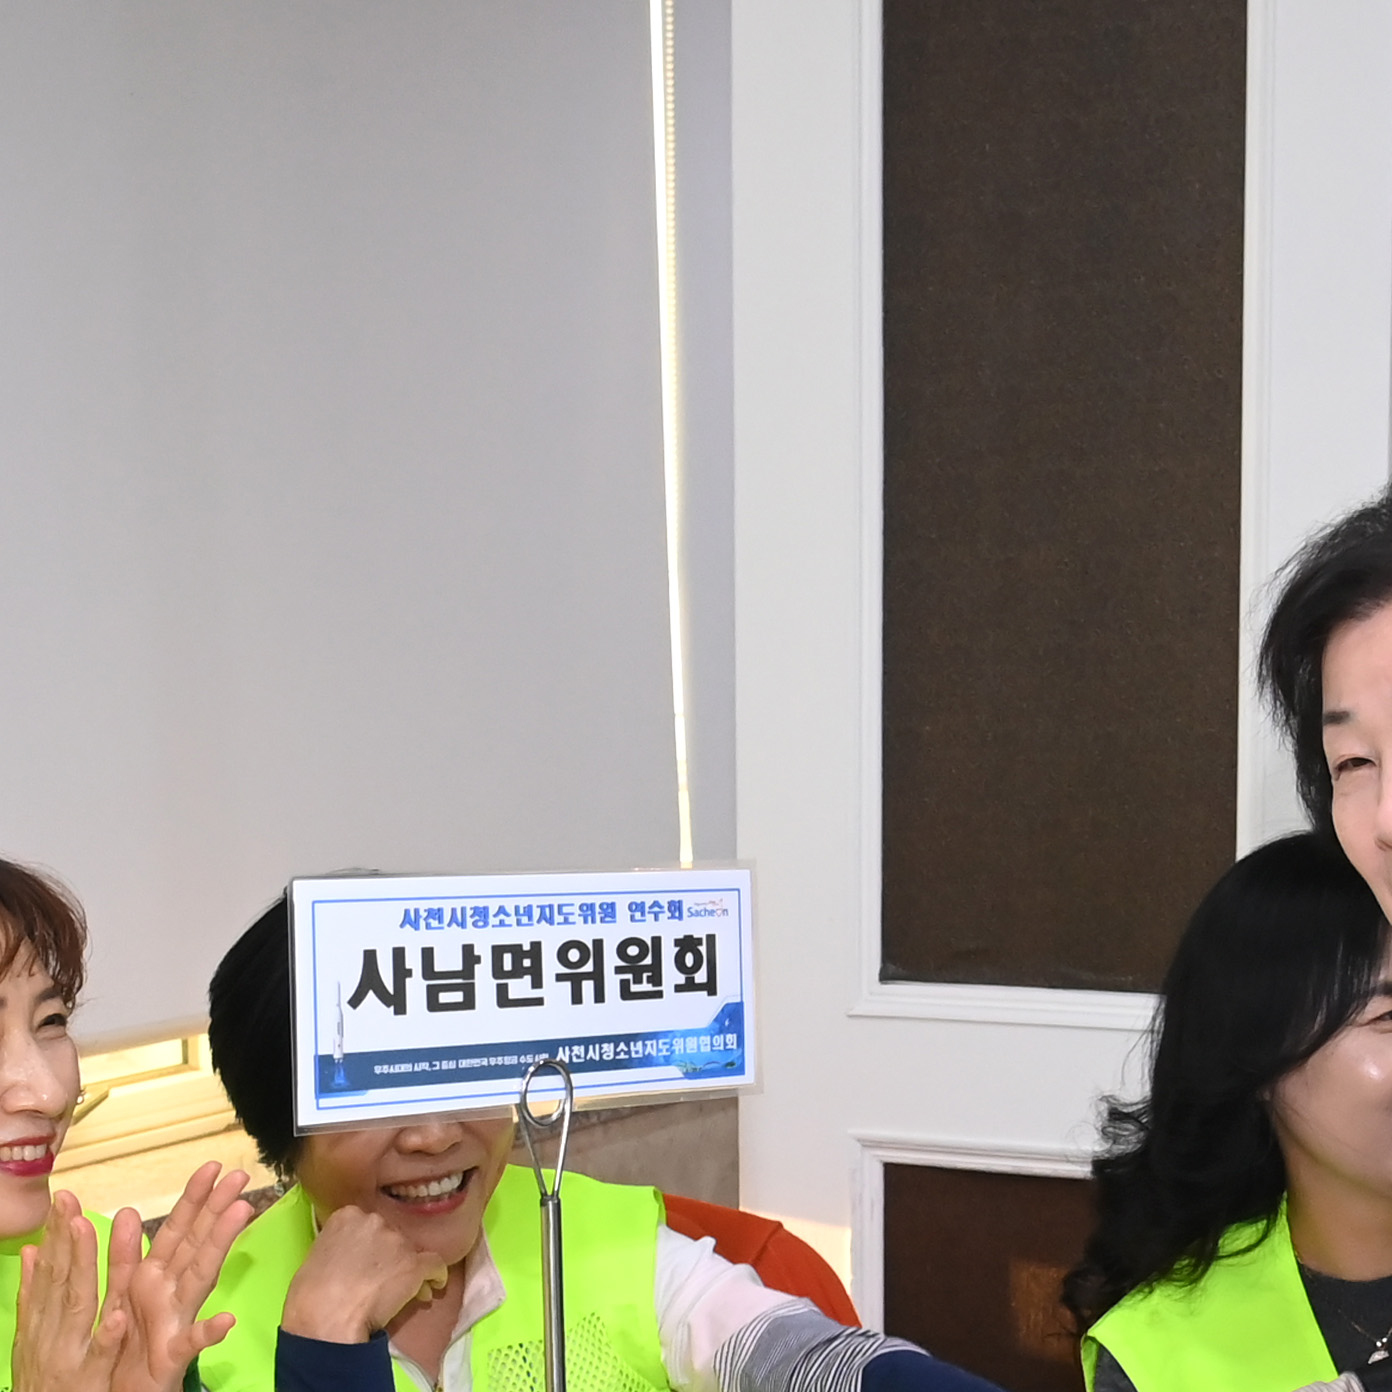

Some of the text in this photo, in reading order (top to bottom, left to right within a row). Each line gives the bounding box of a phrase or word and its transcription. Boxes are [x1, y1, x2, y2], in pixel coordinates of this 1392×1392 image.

[399, 899, 684, 932] 사천시청소년지도위원 연수회
[346, 933, 719, 1017] 사남면위원회
[556, 1034, 738, 1066] 사천시청소년지도위원협의회
